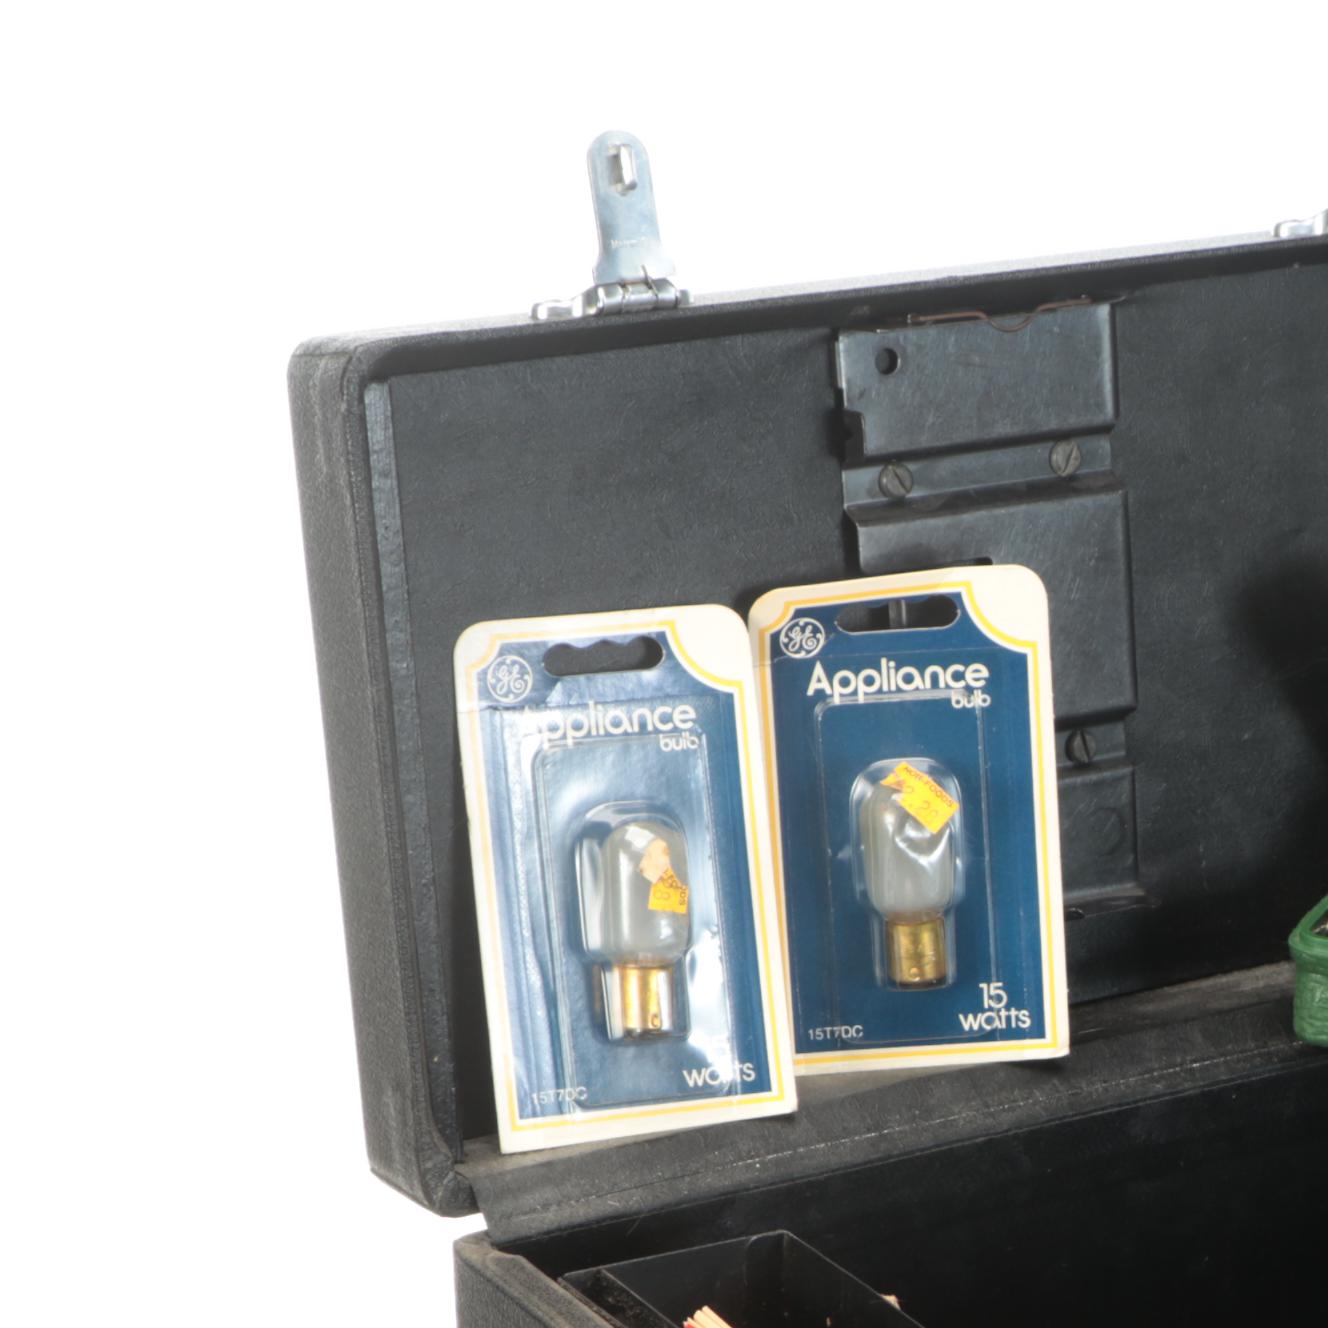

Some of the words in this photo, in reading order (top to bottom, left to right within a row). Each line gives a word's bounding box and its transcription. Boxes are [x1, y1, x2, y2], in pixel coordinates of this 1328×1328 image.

[806, 656, 990, 704] Appliance
[950, 690, 992, 709] bulb
[519, 701, 697, 749] ppliance
[659, 731, 699, 752] bulb
[979, 982, 1009, 1009] 15
[958, 1007, 1032, 1031] watts
[808, 1025, 864, 1041] 15T7DC
[531, 1086, 588, 1105] 15T7DC
